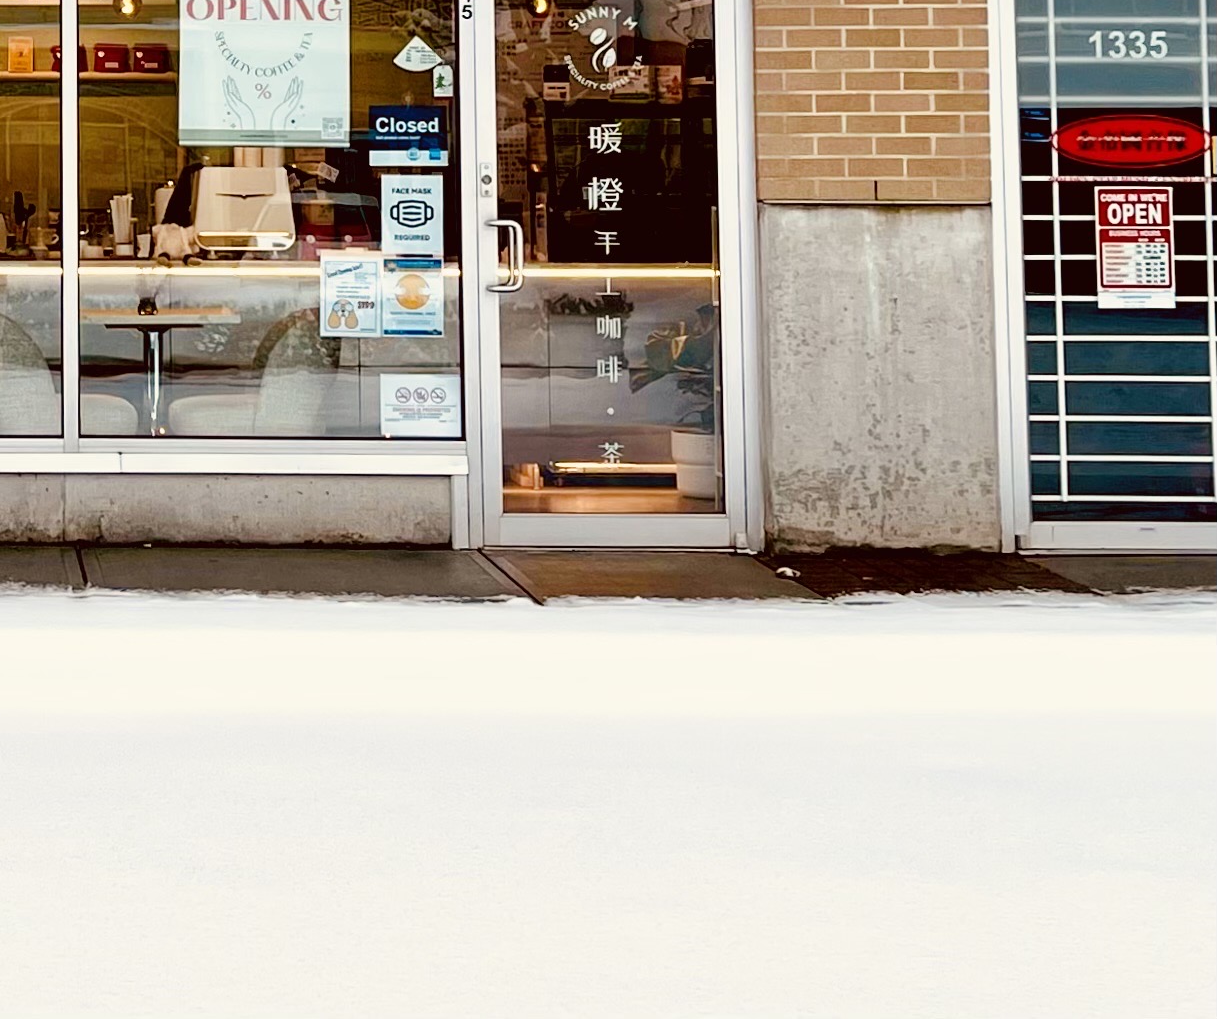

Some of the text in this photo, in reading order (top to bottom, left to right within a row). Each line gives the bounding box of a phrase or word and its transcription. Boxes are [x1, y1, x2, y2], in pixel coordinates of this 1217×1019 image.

[568, 6, 622, 31] SUNNY
[623, 16, 638, 31] M
[214, 30, 252, 76] SPECIALTY
[254, 58, 296, 78] COFFEE
[1089, 30, 1168, 59] 1335
[375, 117, 439, 133] Closed
[391, 187, 433, 195] FACE MASK
[1100, 193, 1126, 202] COME
[1128, 193, 1138, 202] IN
[1107, 203, 1163, 225] OPEN
[393, 234, 431, 242] REQUIRED
